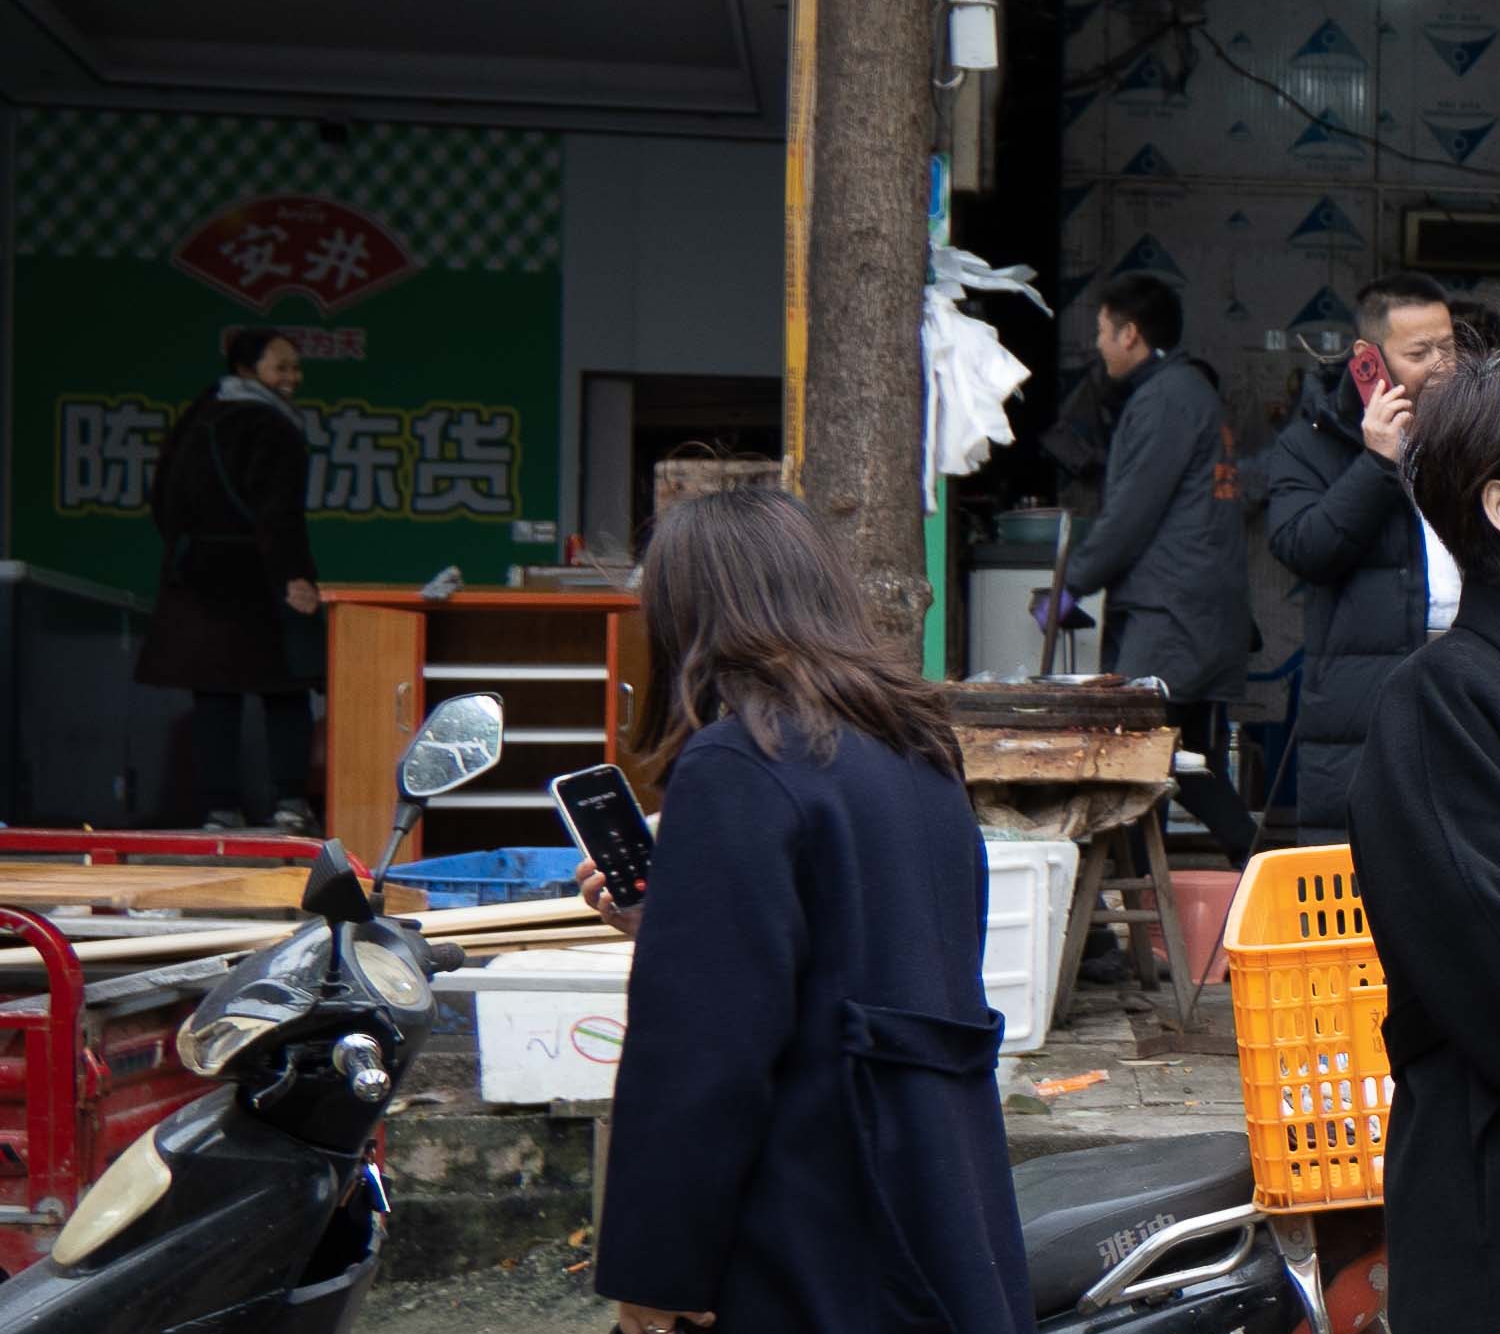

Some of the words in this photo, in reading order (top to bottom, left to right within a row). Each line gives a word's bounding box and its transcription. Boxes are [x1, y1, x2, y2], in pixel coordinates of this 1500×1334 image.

[217, 223, 369, 291] 安井
[62, 401, 514, 514] 陈冻货
